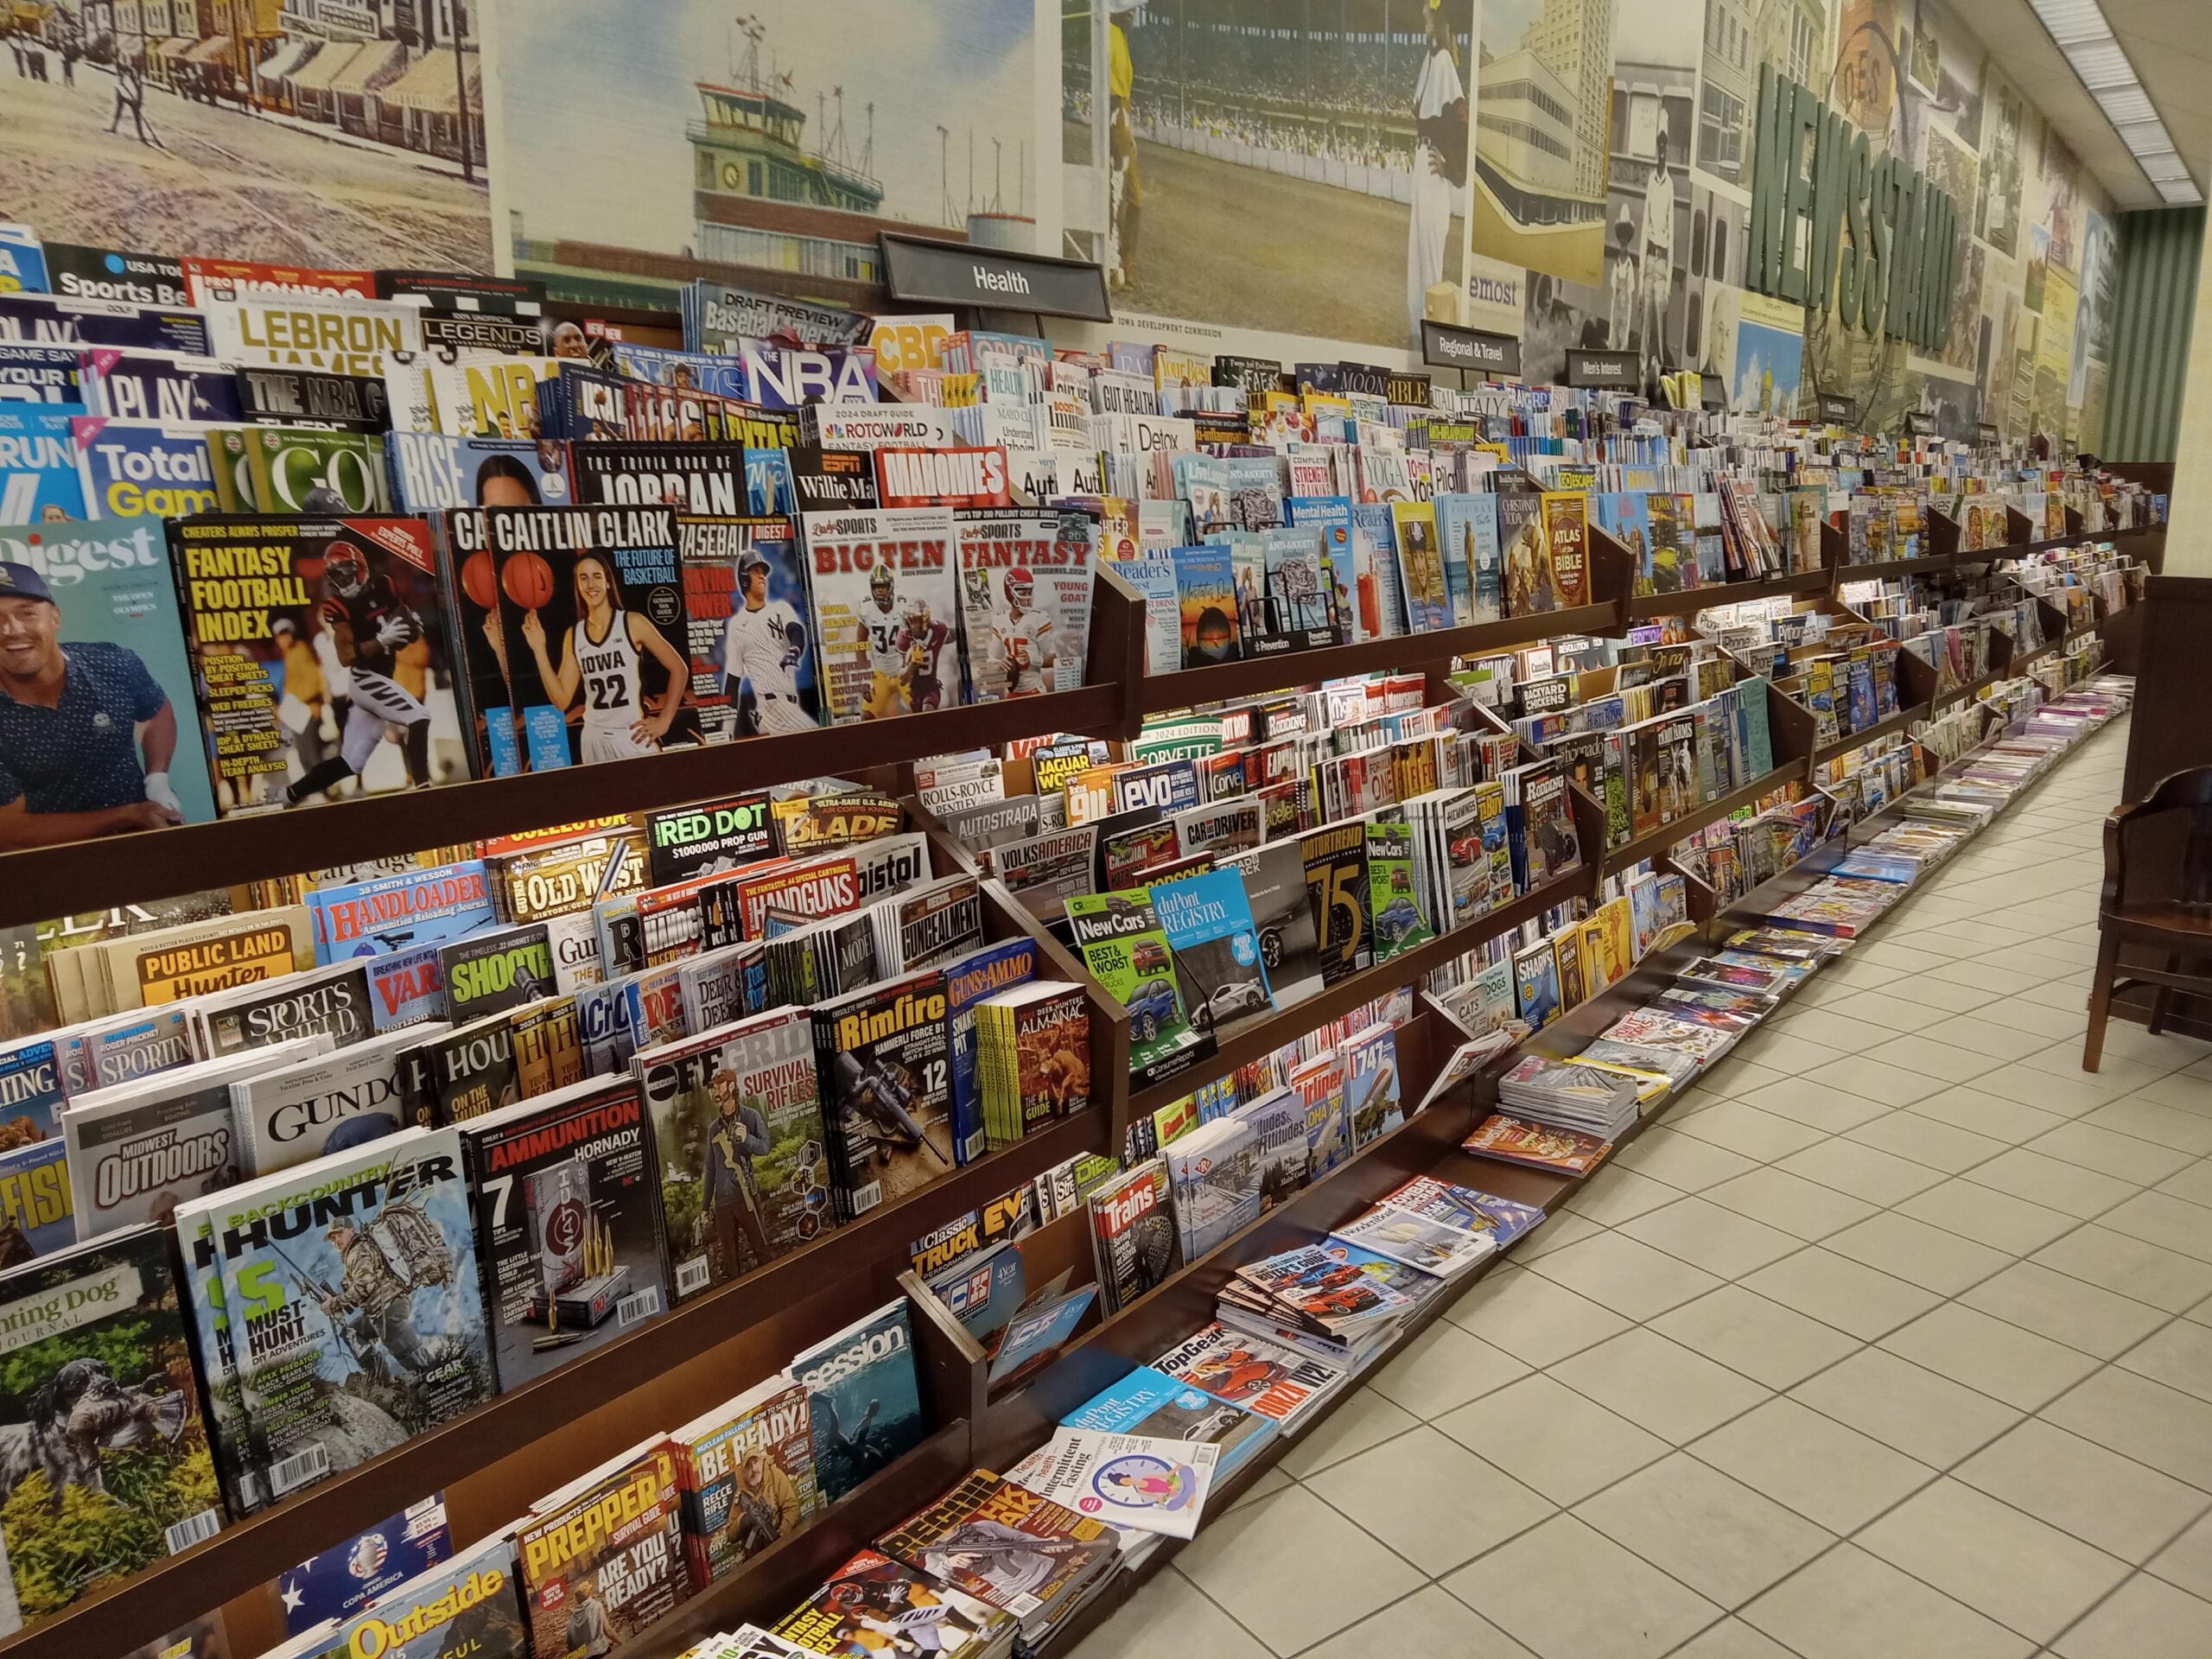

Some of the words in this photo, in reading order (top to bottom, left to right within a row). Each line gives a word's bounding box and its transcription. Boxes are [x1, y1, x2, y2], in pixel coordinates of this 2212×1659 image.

[126, 261, 156, 275] USA
[973, 265, 1030, 295] Health
[60, 273, 153, 303] Sports
[726, 294, 773, 311] DRAFT
[776, 304, 843, 327] PREVIEW
[238, 308, 402, 353] LEBRON
[424, 321, 543, 346] LEGENDS
[1117, 316, 1135, 328] IOWA
[1137, 318, 1182, 332] DEVELOPMENT
[1184, 325, 1223, 339] COMMISSION
[871, 326, 950, 372] CBD
[1440, 337, 1472, 358] Regional
[1474, 342, 1481, 357] &
[1481, 343, 1503, 361] Travel
[744, 351, 874, 410] NBA
[1583, 361, 1600, 374] Men's
[1601, 362, 1622, 376] Interest
[246, 372, 302, 415] THE
[305, 376, 362, 418] NBA
[1103, 385, 1122, 410] GUT
[1124, 389, 1154, 415] HEALTH
[845, 423, 928, 439] ROTOWORLD
[1139, 423, 1179, 452] Detox
[96, 443, 212, 480] Total
[397, 433, 469, 509] RISE
[587, 456, 611, 471] THE
[620, 456, 667, 471] TRIVIA
[675, 456, 708, 470] BOOK
[715, 456, 731, 469] OF
[822, 454, 861, 473] ESPN
[882, 451, 1007, 498] MAHOMES
[1294, 467, 1329, 483] STRENGTH
[1363, 455, 1408, 486] YOGA
[798, 475, 847, 499] Willie
[836, 518, 877, 535] SPORTS
[1294, 506, 1319, 518] Mental
[1320, 506, 1347, 517] Health
[181, 527, 226, 538] CHEATERS
[228, 526, 259, 538] ALWAYS
[261, 525, 298, 537] PROSPER
[497, 512, 594, 550] CAITLIN
[598, 511, 673, 548] CLARK
[756, 526, 786, 540] DIGEST
[981, 524, 1021, 538] SPORTS
[1268, 539, 1315, 550] ANTI-ANXIETY
[1554, 529, 1580, 543] ATLAS
[185, 546, 291, 577] FANTASY
[614, 551, 629, 567] THE
[630, 550, 663, 567] FUTURE
[664, 549, 675, 564] OF
[812, 544, 874, 575] BIG
[878, 539, 946, 568] TEN
[961, 540, 1091, 568] FANTASY
[1555, 555, 1582, 571] BIBLE
[624, 564, 677, 585] BASKETBALL
[1053, 582, 1088, 591] YOUNG
[192, 578, 311, 610] FOOTBALL
[1060, 594, 1088, 602] GOAT
[196, 609, 272, 642] INDEX
[1261, 639, 1289, 652] Prevention
[581, 651, 626, 674] IOWA
[208, 686, 245, 697] SLEEPER
[246, 683, 274, 694] PICKS
[589, 674, 629, 709] 22
[1524, 685, 1567, 700] BACKYARD
[1525, 696, 1565, 710] CHICKENS
[1155, 728, 1175, 739] 2024
[1178, 725, 1219, 736] EDITION
[219, 756, 260, 768] IN-DEPTH
[221, 766, 245, 778] TEAM
[245, 760, 288, 774] ANALYSIS
[1038, 756, 1089, 775] JAGUAR
[924, 779, 995, 806] ROLLS-ROYCE
[1124, 772, 1172, 811] evo
[660, 816, 710, 847] RED
[716, 803, 767, 839] DOT
[958, 804, 1038, 839] AUTOSTRADA
[1213, 810, 1254, 837] DRIVER
[1446, 800, 1477, 821] HEMMINGS
[721, 836, 744, 849] PROP
[747, 830, 768, 845] GUN
[1001, 831, 1091, 869] VOLKSAMERICA
[1187, 824, 1207, 847] CAR
[1302, 827, 1362, 861] MOTORTREND
[818, 864, 851, 880] CARTRIDGE
[528, 874, 577, 910] OLD
[752, 873, 852, 936] HANDGUNS
[1158, 892, 1200, 916] duPont
[329, 874, 487, 942] HANDLOADER
[363, 918, 414, 936] Ammunition
[415, 906, 456, 925] Reloading
[458, 899, 488, 913] Journal
[1306, 865, 1363, 962] 75
[1079, 919, 1110, 939] New
[1109, 912, 1146, 932] Cars
[145, 948, 226, 979] PUBLIC
[231, 931, 285, 959] LAND
[1089, 948, 1112, 961] BEST
[1113, 946, 1121, 957] &
[1092, 957, 1129, 976] WORST
[1519, 949, 1554, 982] SHARKS!
[173, 964, 270, 1000] Hunter
[247, 982, 351, 1037] SPORTS
[840, 994, 946, 1051] Rimfire
[1020, 1002, 1085, 1036] ALMANAC
[1037, 1005, 1053, 1016] DEER
[1459, 999, 1479, 1020] CATS
[874, 1036, 907, 1056] HAMMERLI
[908, 1027, 933, 1043] FORCE
[935, 1024, 945, 1034] B1
[744, 1058, 813, 1096] SURVIVAL
[923, 1059, 947, 1091] 12
[1357, 1048, 1383, 1075] 747
[766, 1078, 815, 1111] RIFLES
[1027, 1101, 1051, 1121] GUIDE
[122, 1129, 177, 1160] MIDWEST
[492, 1100, 639, 1172] AMMUNITION
[575, 1128, 639, 1163] HORNADY
[1258, 1122, 1304, 1155] Attitudes
[98, 1130, 229, 1207] OUTDOORS
[227, 1161, 391, 1229] BACKCOUNTRY
[482, 1174, 514, 1228] 7
[1382, 1177, 1436, 1204] COMBAT
[223, 1155, 458, 1260] HUNTER
[1106, 1185, 1153, 1234] Trains
[923, 1216, 968, 1249] Classic
[912, 1225, 979, 1273] TRUCK
[923, 1249, 973, 1280] PERFORMANCE
[1258, 1262, 1296, 1281] BUYER'S
[1297, 1254, 1331, 1269] GUIDE
[237, 1260, 285, 1319] 5
[247, 1300, 307, 1337] MUST-
[250, 1318, 305, 1357] HUNT
[1154, 1328, 1230, 1375] TopGear
[802, 1325, 904, 1389] session
[1292, 1362, 1338, 1388] V12!
[1250, 1383, 1311, 1419] FORZA
[701, 1446, 730, 1484] BE
[734, 1405, 808, 1465] READY!
[1039, 1438, 1082, 1498] Intermittent
[1062, 1452, 1092, 1489] Fasting
[524, 1475, 658, 1580] PREPPER
[599, 1556, 630, 1592] ARE
[632, 1533, 666, 1569] YOU
[342, 1592, 365, 1610] COPA
[365, 1571, 404, 1599] AMERICA
[607, 1556, 668, 1612] READY?
[348, 1568, 505, 1659] Outside
